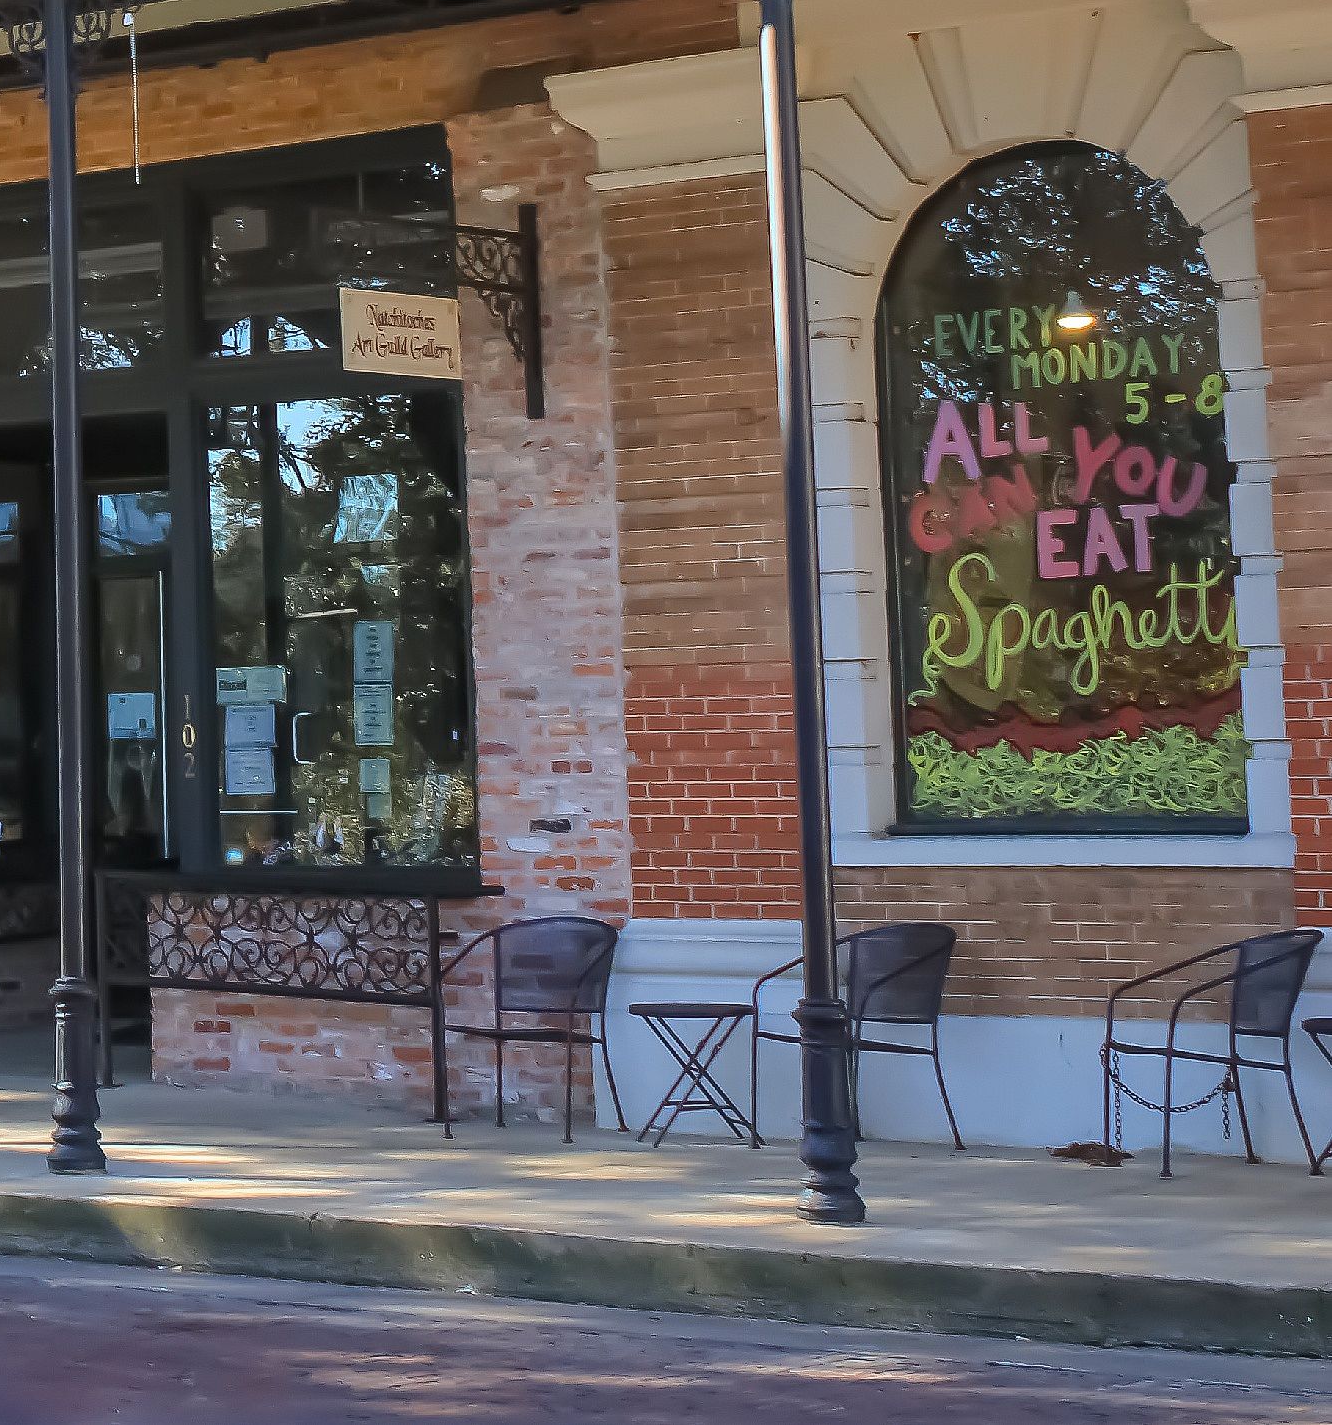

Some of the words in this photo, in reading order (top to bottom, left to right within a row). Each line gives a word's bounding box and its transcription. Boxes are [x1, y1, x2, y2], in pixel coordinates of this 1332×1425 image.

[351, 332, 373, 358] Art
[375, 333, 408, 358] Guild
[410, 336, 453, 370] Gallery
[935, 304, 1055, 357] EVERY
[1011, 333, 1185, 389] MONDAY
[922, 400, 1050, 483] ALL
[1072, 425, 1207, 518] YOU
[910, 463, 1038, 554] CAN
[1036, 503, 1160, 579] EAT
